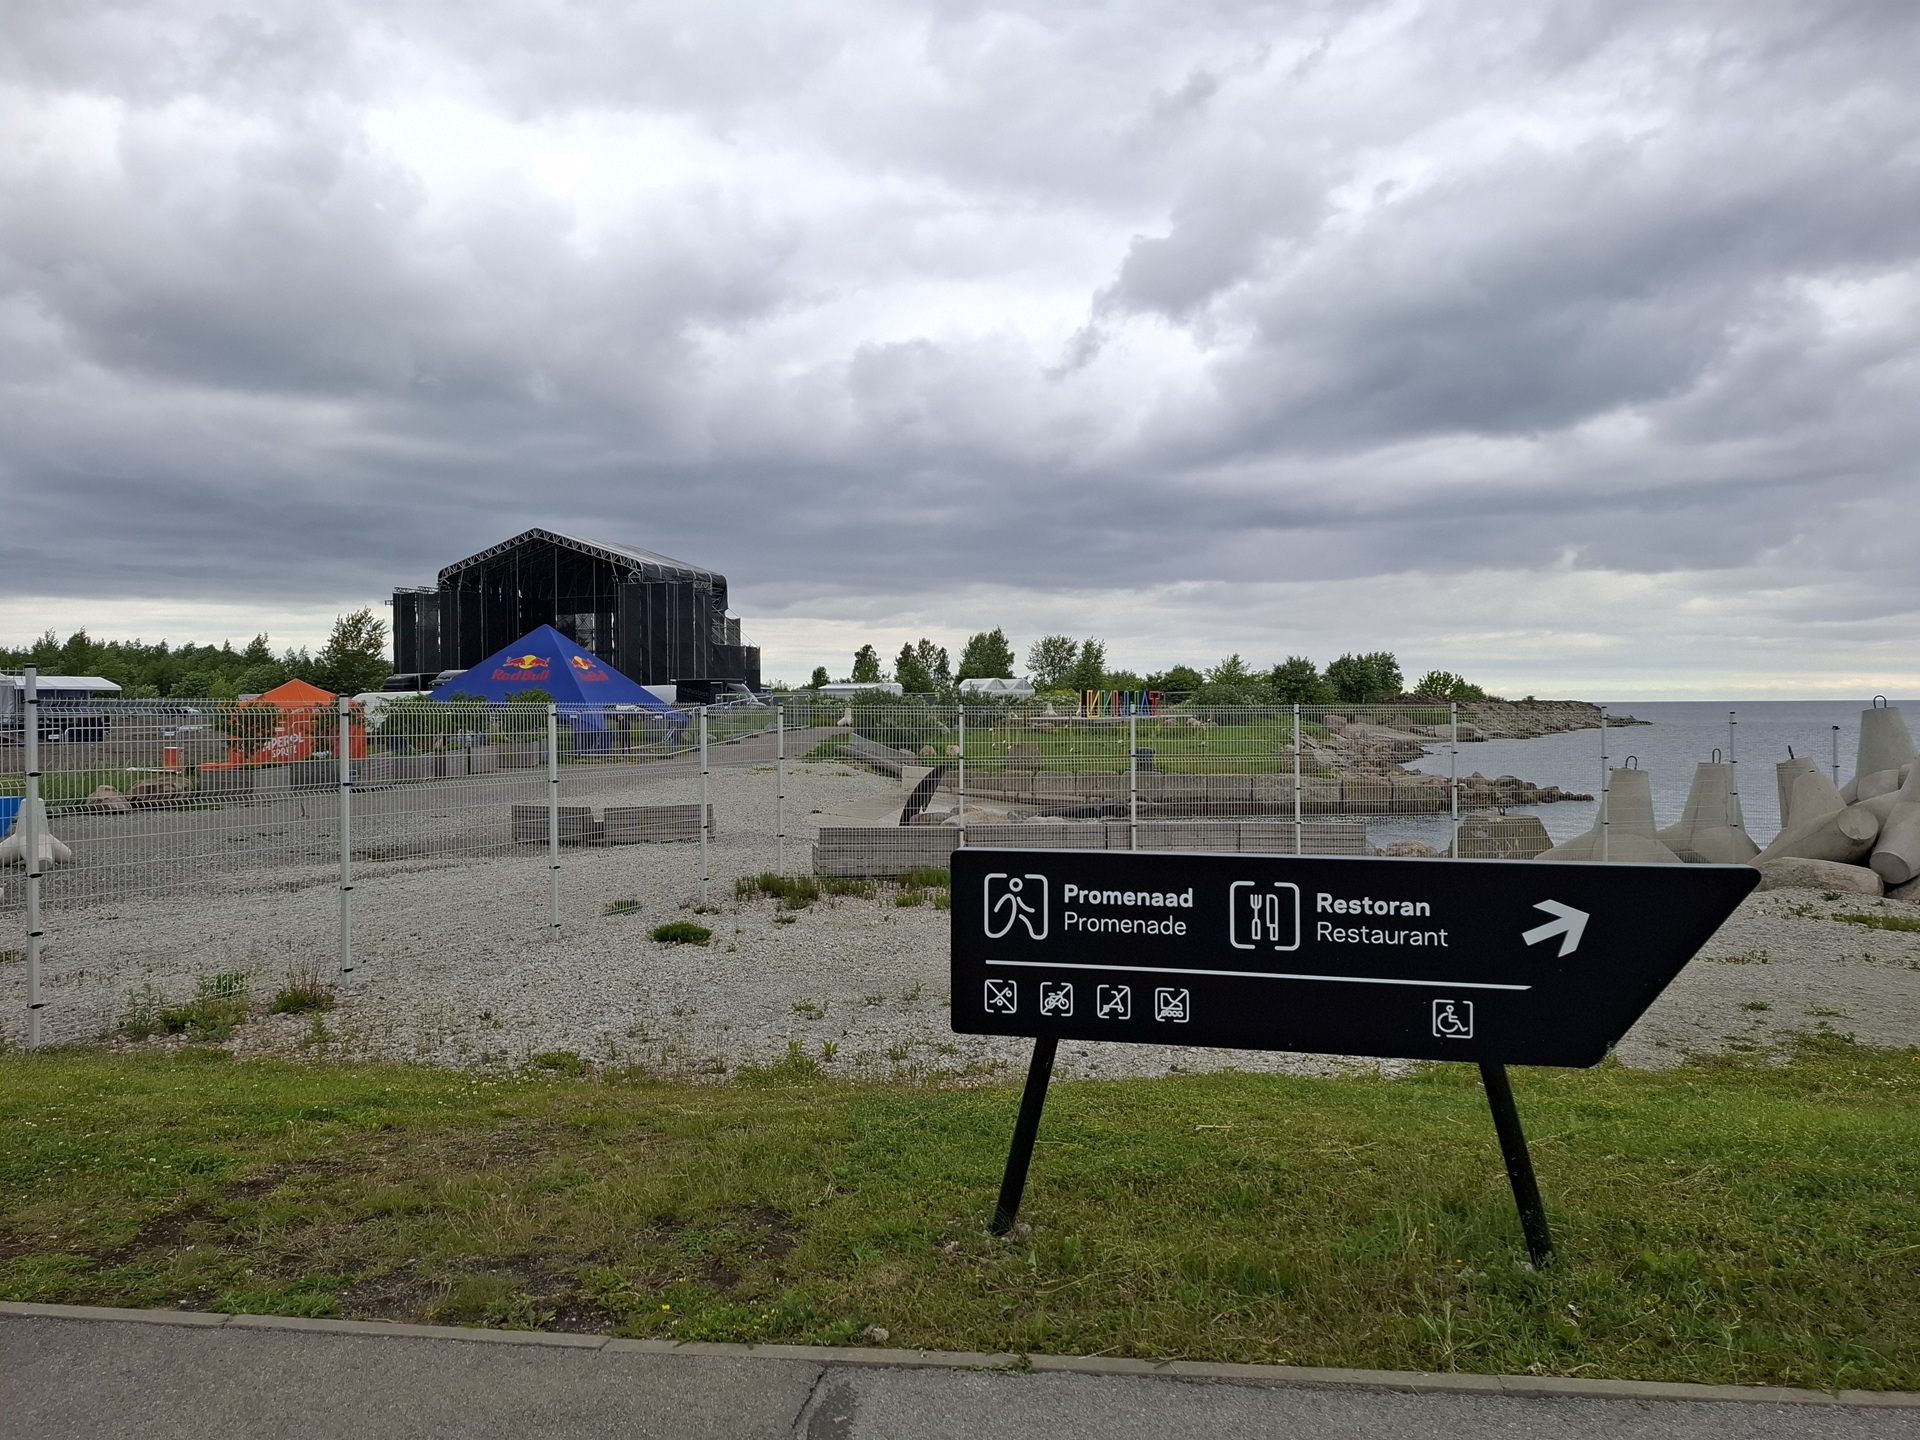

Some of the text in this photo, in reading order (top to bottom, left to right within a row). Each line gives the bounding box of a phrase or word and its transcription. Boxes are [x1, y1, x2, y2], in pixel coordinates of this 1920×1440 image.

[491, 669, 551, 681] Red Bull
[1063, 884, 1194, 908] Promenaad
[1316, 892, 1431, 917] Restoran
[1063, 911, 1188, 936] Promenade
[1317, 921, 1449, 947] Restaurant
